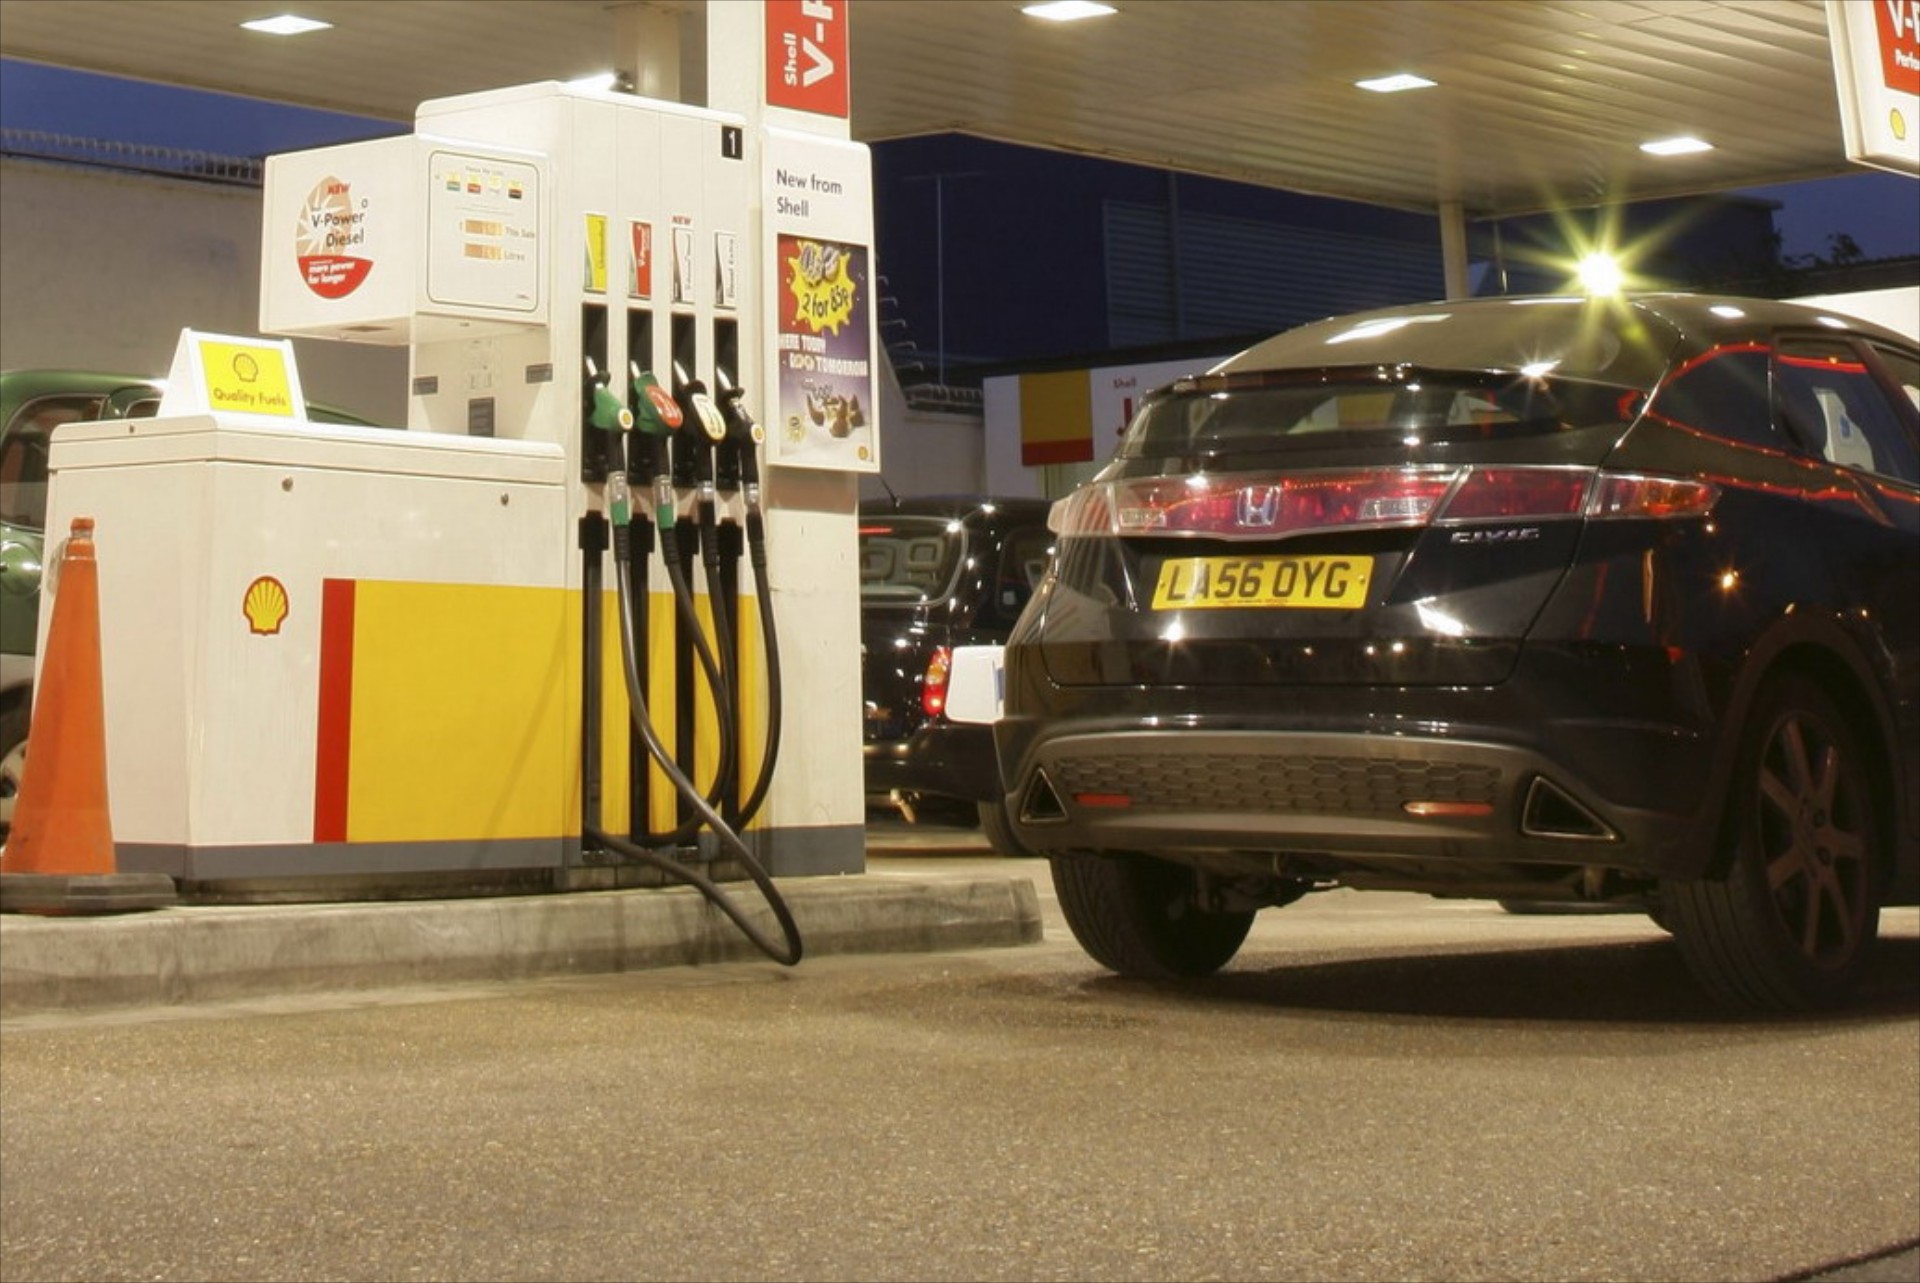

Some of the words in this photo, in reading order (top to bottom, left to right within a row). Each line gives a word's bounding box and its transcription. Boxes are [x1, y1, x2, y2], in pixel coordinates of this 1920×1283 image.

[783, 32, 798, 87] Shell
[727, 129, 738, 156] 1
[776, 168, 807, 188] New
[810, 173, 843, 195] from
[311, 212, 365, 228] V-Power
[776, 196, 809, 218] Shell
[325, 228, 365, 247] Diesel
[802, 292, 811, 314] 2
[812, 293, 829, 319] for
[213, 387, 255, 406] Quality
[1166, 561, 1265, 601] LA56
[1272, 560, 1351, 599] OYG
